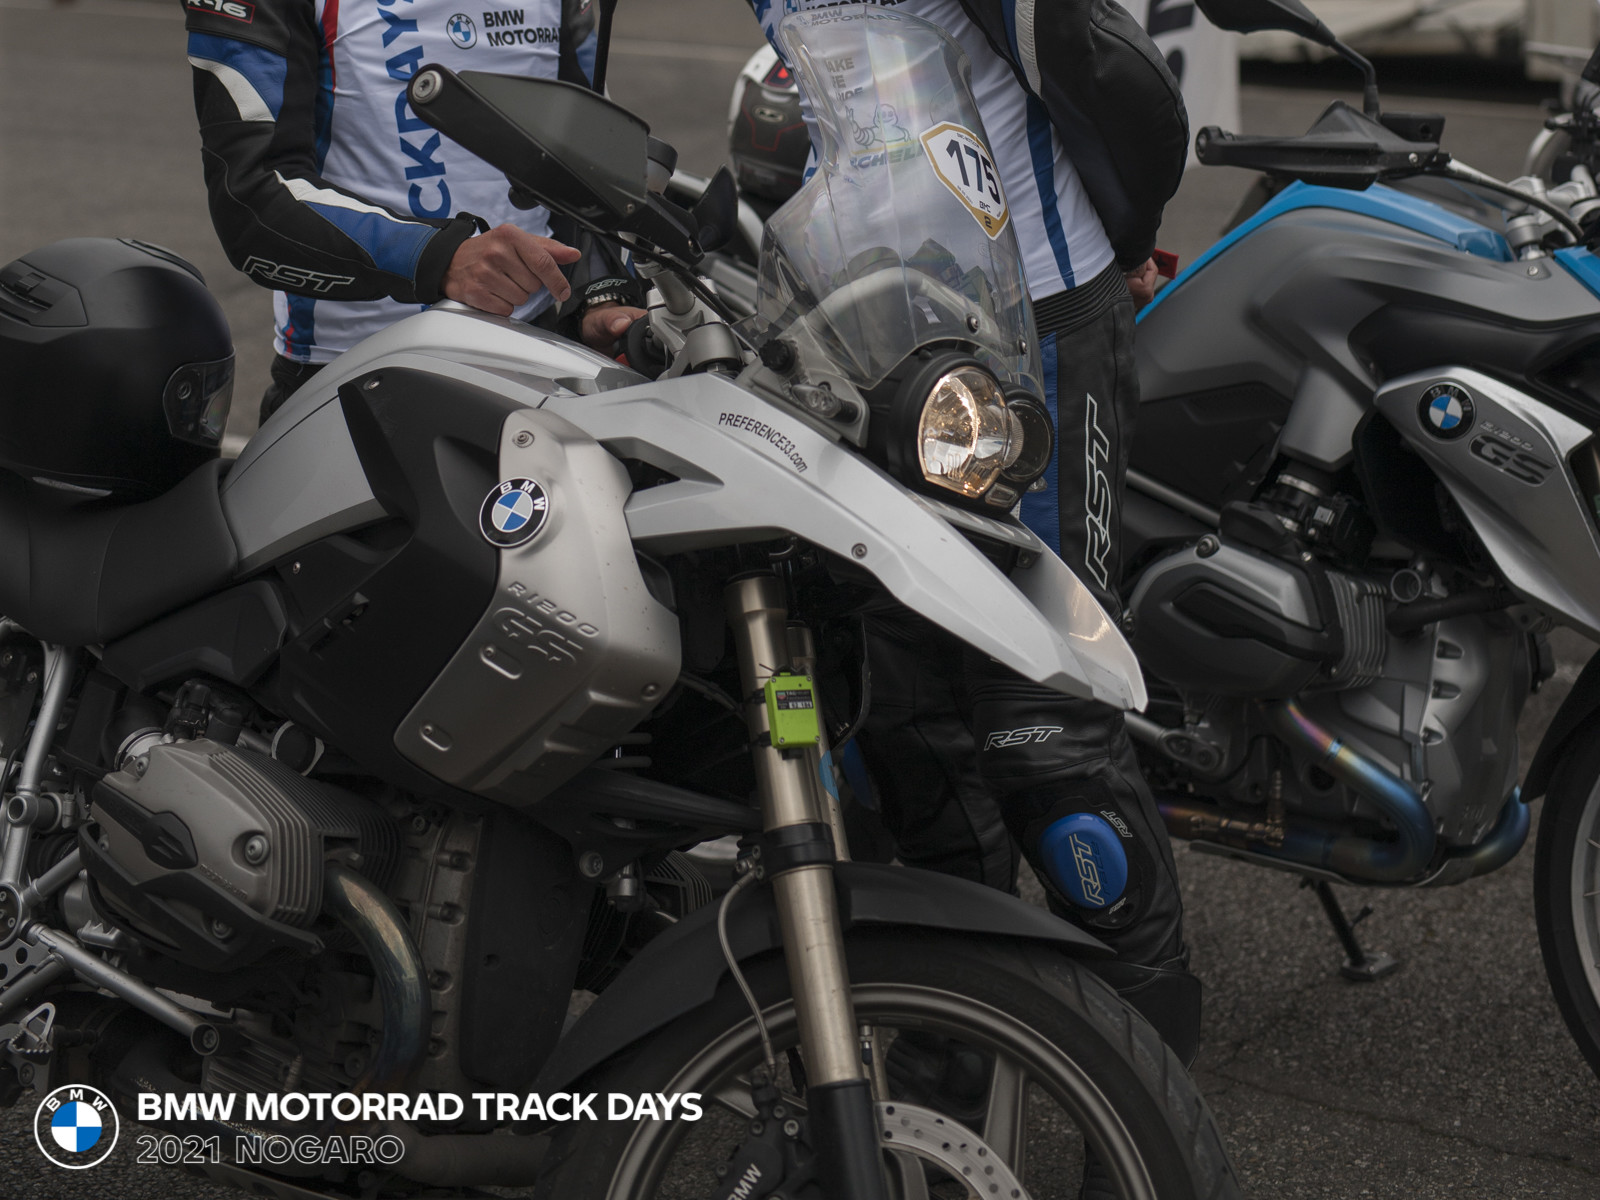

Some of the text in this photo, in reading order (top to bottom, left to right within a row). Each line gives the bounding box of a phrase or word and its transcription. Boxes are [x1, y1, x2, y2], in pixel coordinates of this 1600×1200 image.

[482, 9, 524, 28] BMW
[486, 26, 561, 47] MOTORRA
[945, 139, 1001, 205] 175
[984, 215, 993, 229] 2
[242, 255, 356, 293] RST
[585, 278, 628, 295] RST
[718, 412, 808, 473] PREFERENCE33.com
[1470, 435, 1553, 485] GS
[500, 479, 546, 511] BMW
[1086, 392, 1112, 591] RST
[508, 580, 600, 638] R1200
[983, 725, 1064, 752] RST
[1100, 810, 1133, 838] RST
[1069, 833, 1105, 906] RST
